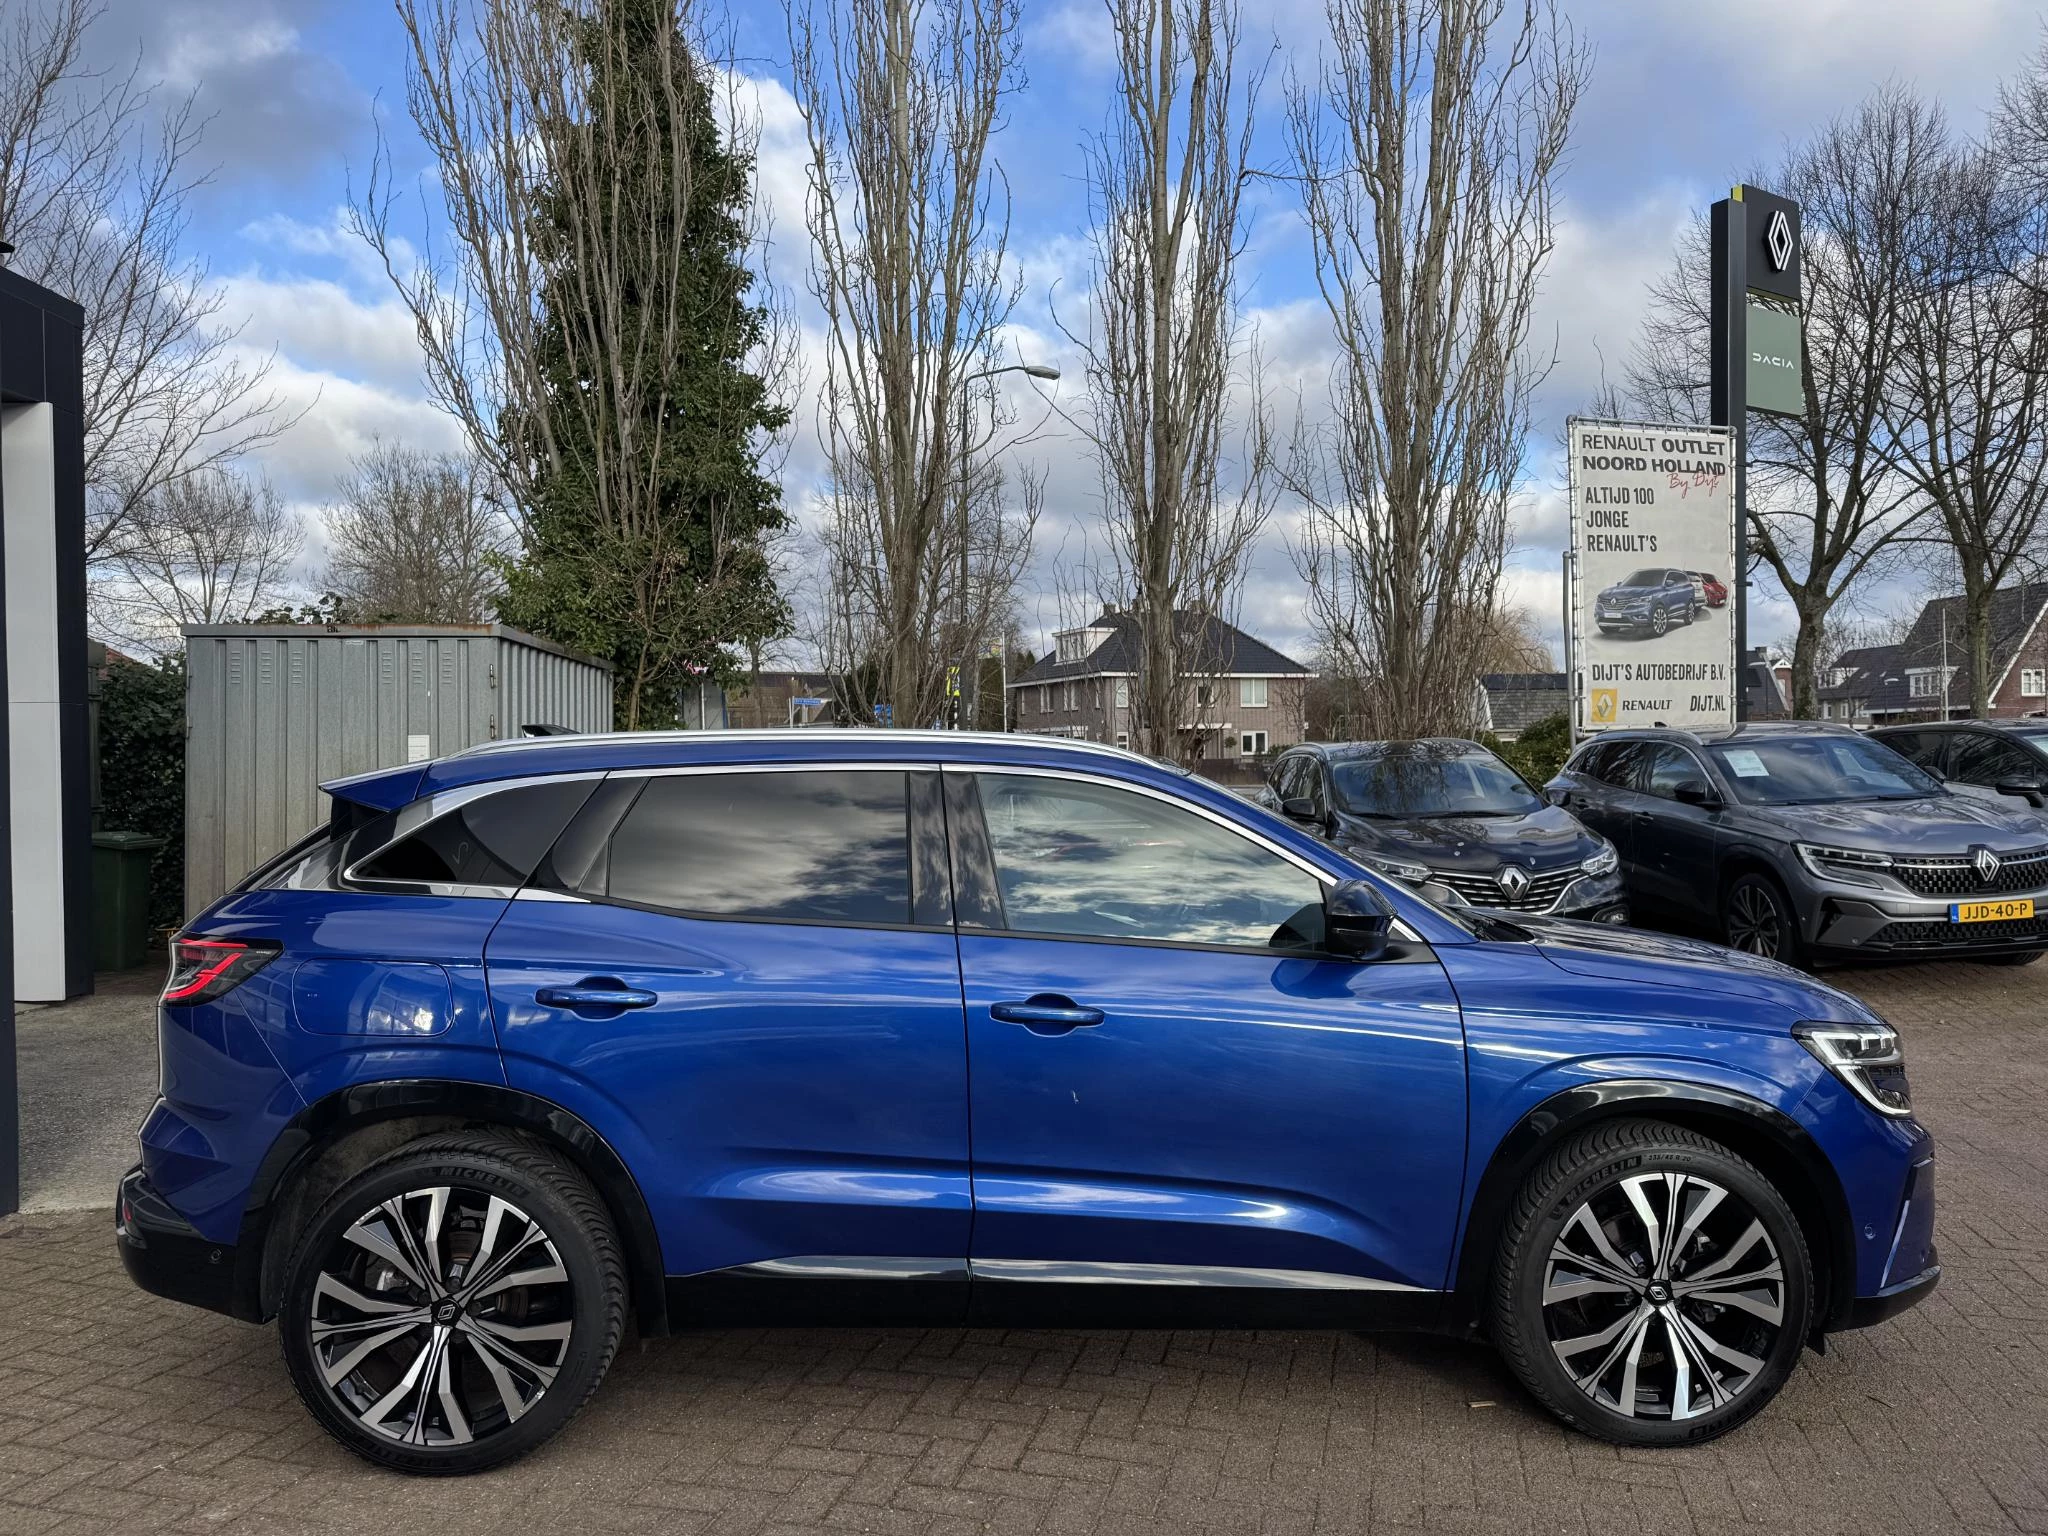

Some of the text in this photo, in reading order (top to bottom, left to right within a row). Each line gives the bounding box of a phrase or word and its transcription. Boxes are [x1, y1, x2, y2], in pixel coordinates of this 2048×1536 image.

[1752, 352, 1794, 370] DACIA
[1582, 434, 1725, 456] RENAULT OUTLET
[1582, 456, 1726, 476] NOORD HOLLAND
[1667, 472, 1689, 499] By
[1585, 486, 1655, 505] ALTIJD 100
[1586, 510, 1630, 528] JONGE
[1587, 534, 1658, 552] RENAULT'S
[1592, 663, 1726, 681] DIJT'S AUTOBEDRIJF B.V.
[1622, 695, 1726, 712] RENAULT DIJT.NL
[1964, 902, 2027, 920] JJD-40-P
[439, 1166, 527, 1197] MICHELIN
[1565, 1156, 1639, 1205] MICHELIN
